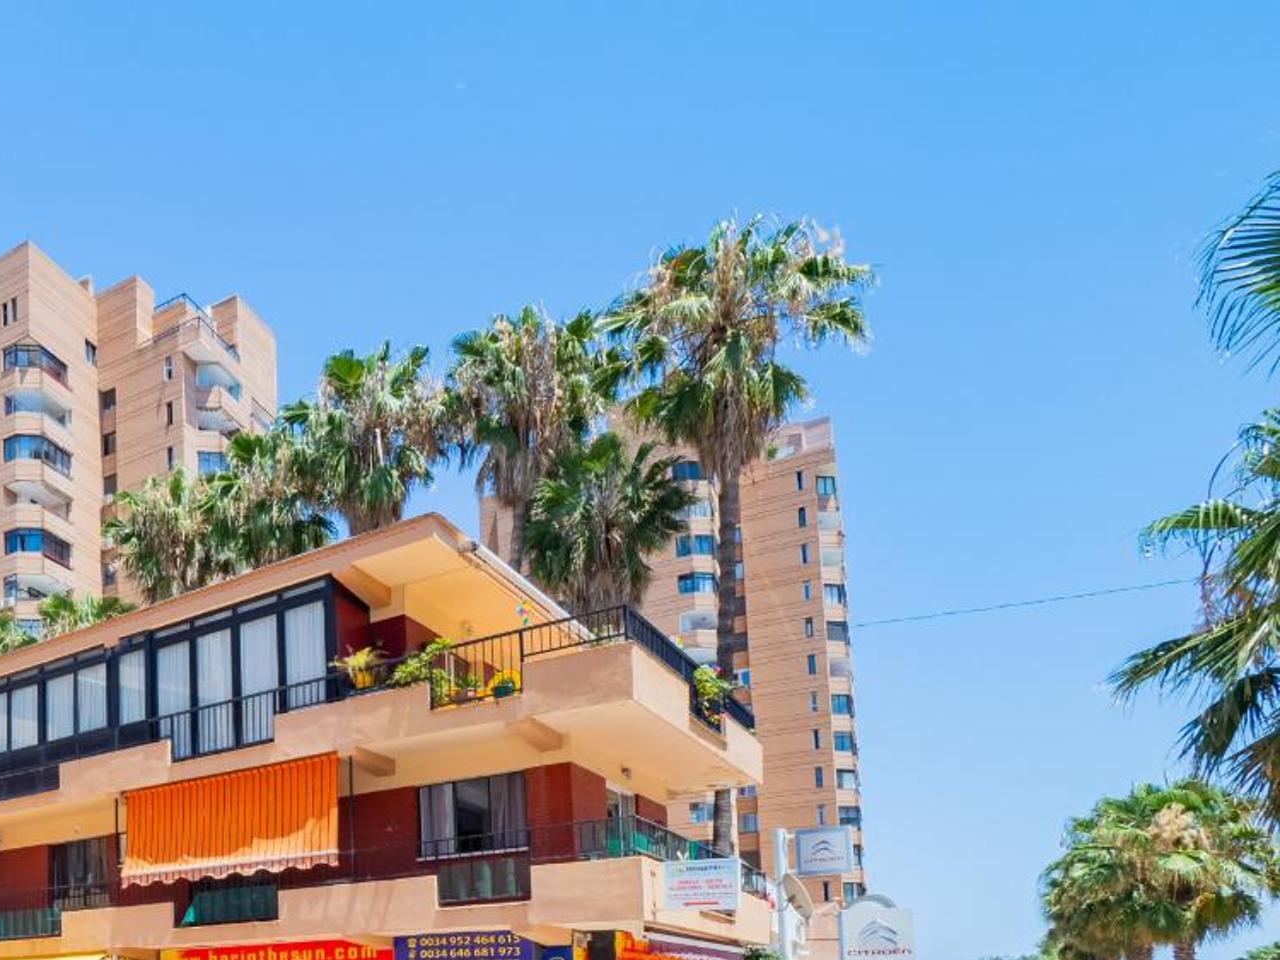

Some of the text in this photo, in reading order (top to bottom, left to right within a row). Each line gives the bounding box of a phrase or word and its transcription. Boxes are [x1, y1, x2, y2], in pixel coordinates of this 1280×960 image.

[420, 935, 447, 947] 0034
[449, 935, 471, 946] 952
[420, 949, 447, 959] 0034
[498, 947, 521, 956] 973
